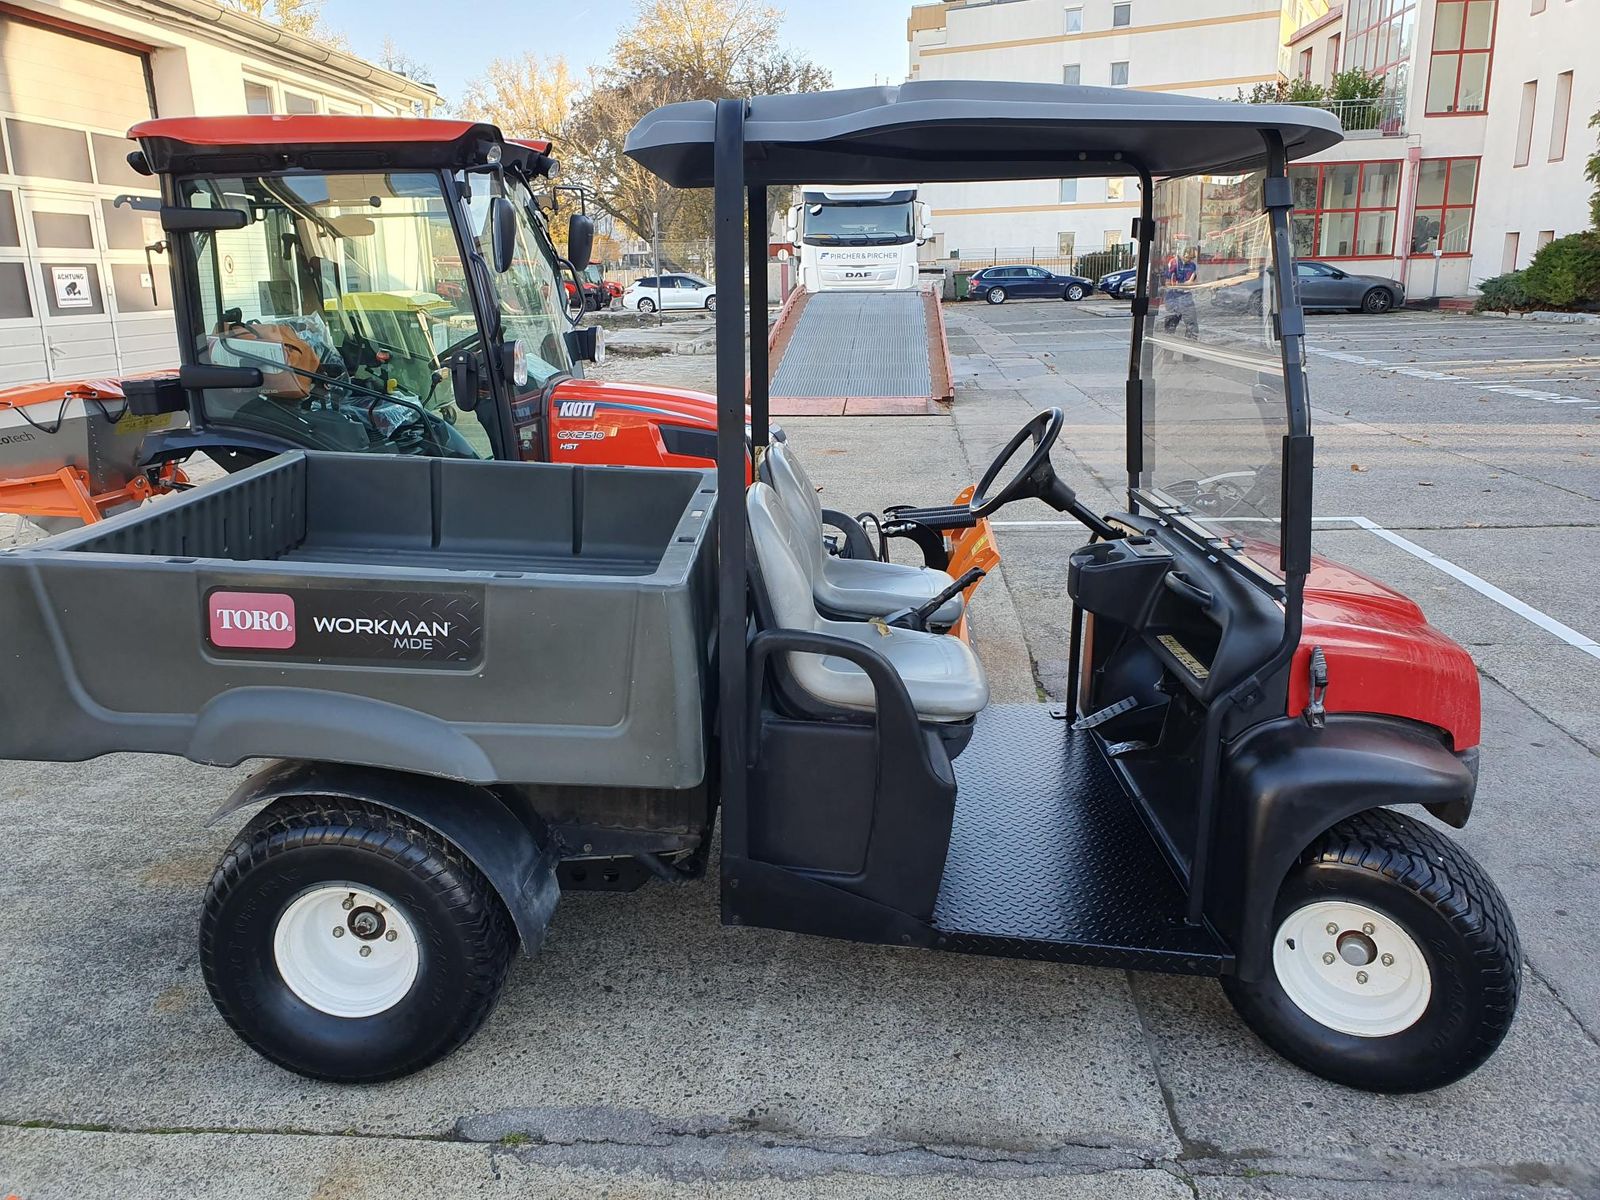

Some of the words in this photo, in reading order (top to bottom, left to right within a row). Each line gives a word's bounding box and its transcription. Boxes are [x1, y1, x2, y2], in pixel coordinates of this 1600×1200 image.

[867, 252, 898, 260] PIRCHER
[560, 402, 595, 417] KIOTI
[0, 431, 37, 446] otech
[557, 430, 605, 440] CX2510
[216, 609, 292, 631] TORO
[313, 616, 450, 637] WORKMAN
[393, 638, 433, 650] MDE
